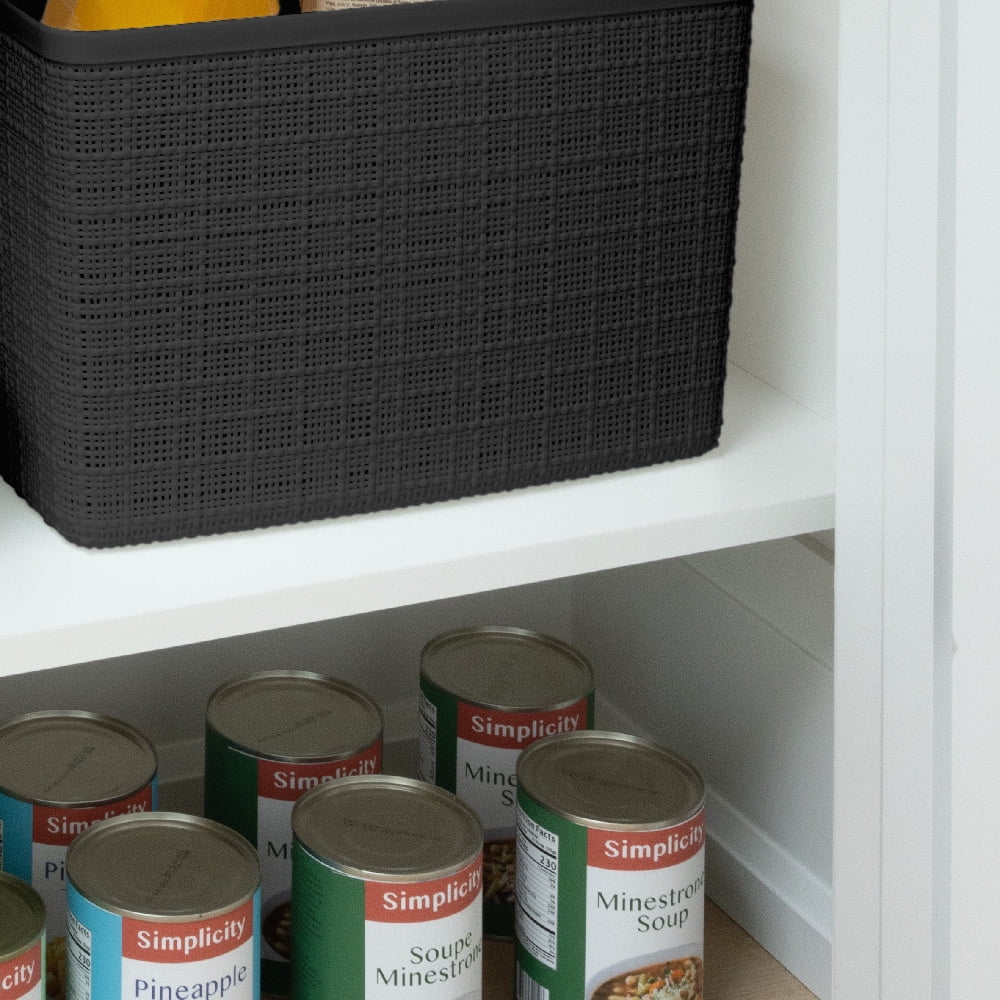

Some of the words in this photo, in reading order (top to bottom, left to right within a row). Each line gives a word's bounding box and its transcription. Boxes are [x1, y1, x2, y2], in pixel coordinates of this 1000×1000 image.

[471, 713, 580, 742] Simplicity
[47, 801, 147, 834] Simlity
[536, 823, 556, 843] Facts
[604, 823, 704, 862] Simplicity
[540, 855, 557, 871] 230
[383, 866, 481, 912] Simplicity
[137, 916, 246, 955] Simplicity
[637, 908, 688, 933] Soup
[78, 952, 91, 967] 230
[410, 929, 473, 965] Soupe
[135, 964, 247, 1000] Pineapple
